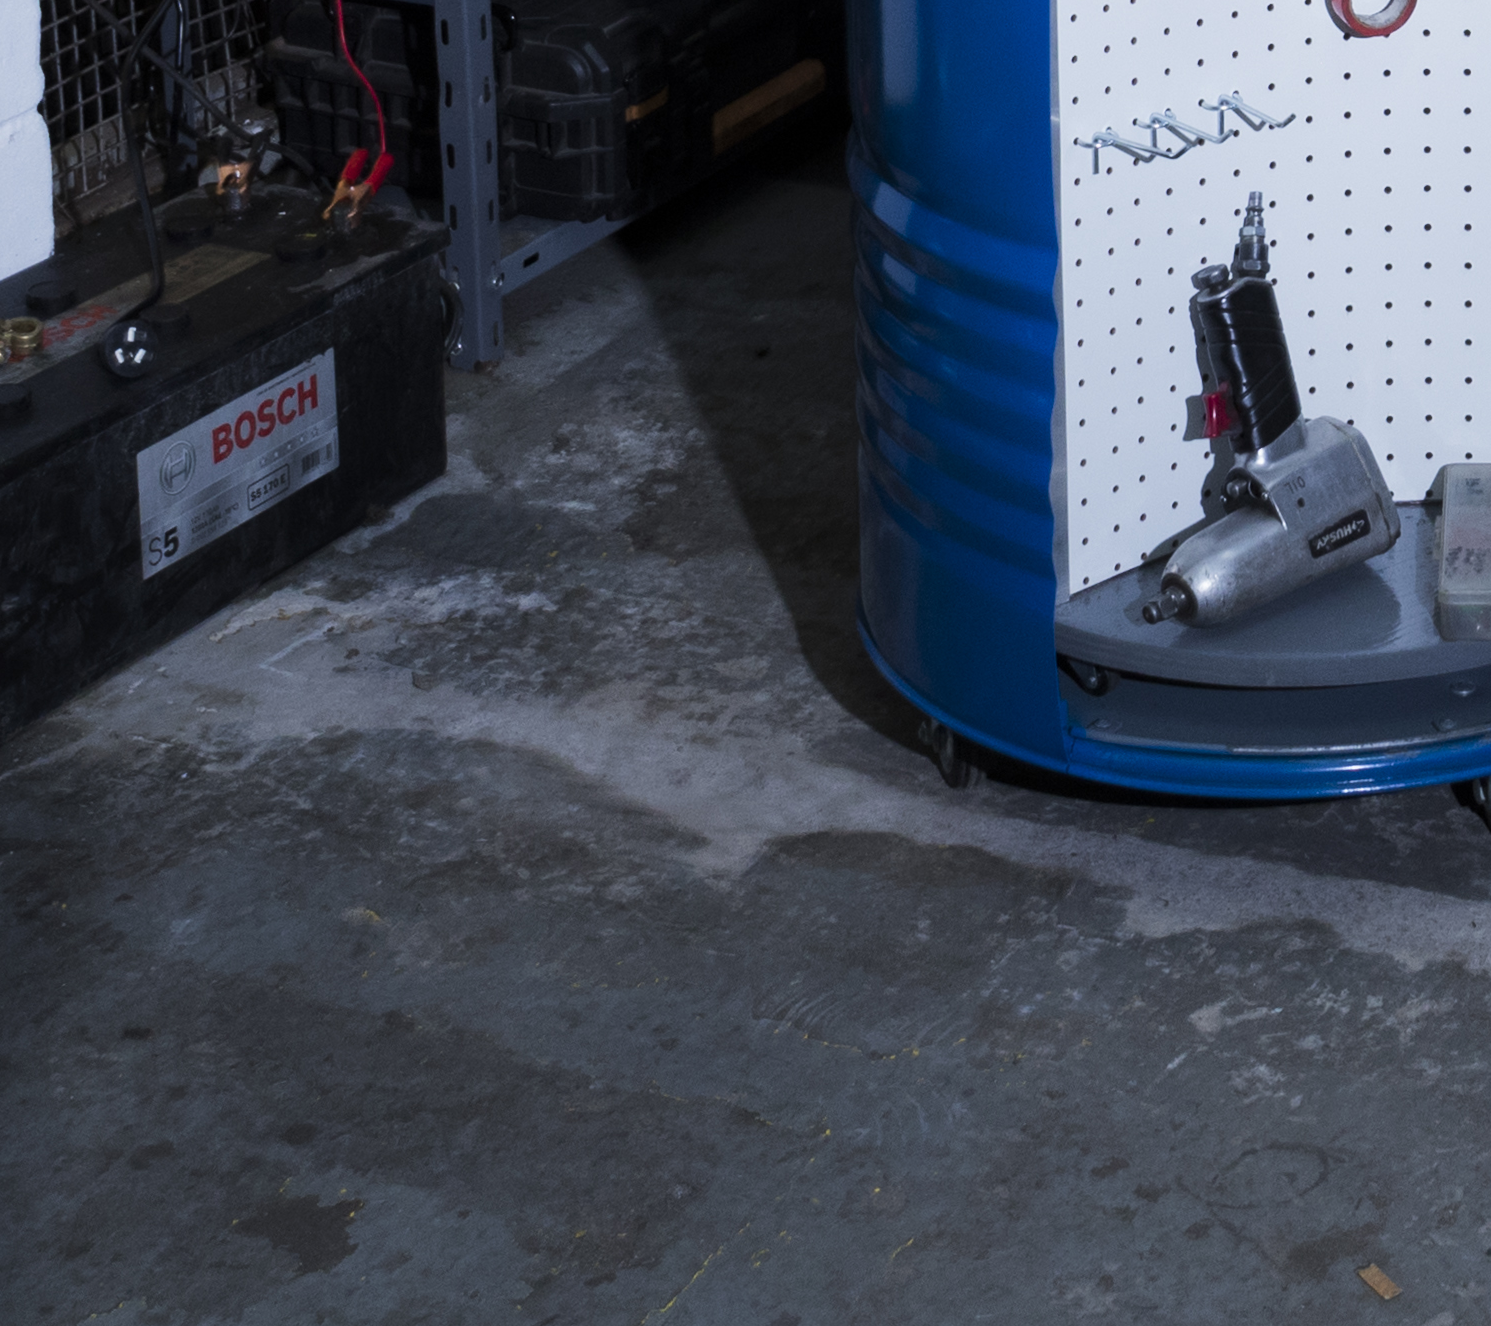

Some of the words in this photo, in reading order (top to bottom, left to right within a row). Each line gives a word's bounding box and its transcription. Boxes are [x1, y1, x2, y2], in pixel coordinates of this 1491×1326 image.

[212, 374, 318, 464] BOSCH
[264, 478, 279, 494] 170
[149, 526, 180, 566] S5
